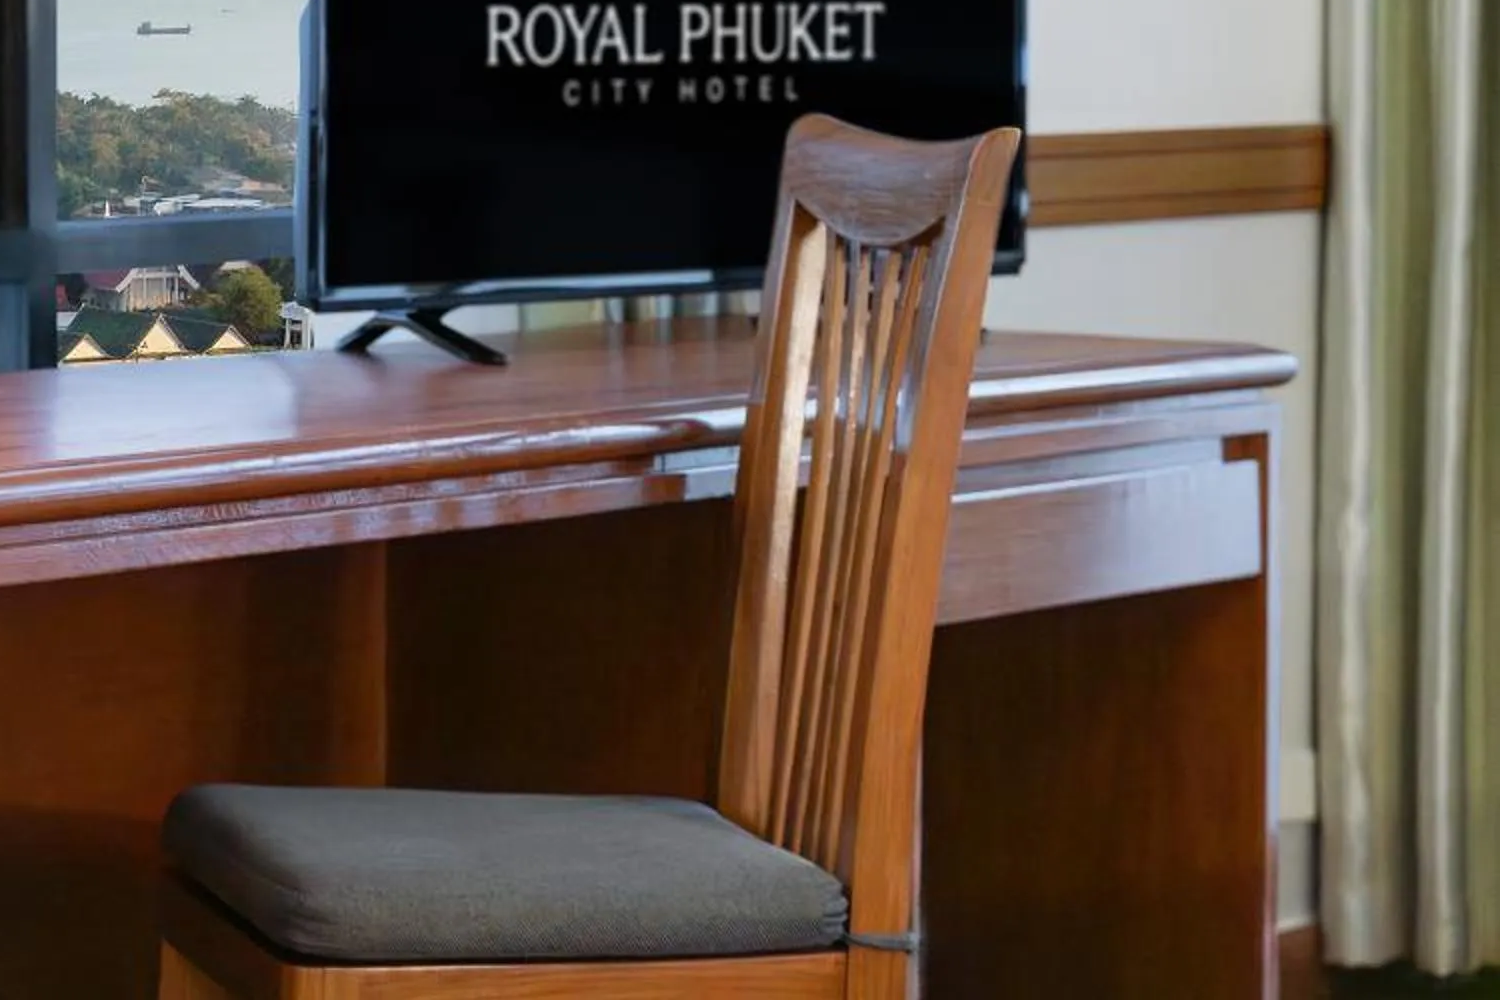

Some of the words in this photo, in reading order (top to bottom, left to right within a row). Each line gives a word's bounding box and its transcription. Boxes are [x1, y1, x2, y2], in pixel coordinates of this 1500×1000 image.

[487, 4, 663, 66] ROYAL
[681, 2, 886, 63] PHUKET
[562, 78, 654, 107] CITY
[679, 75, 800, 104] HOTEL
